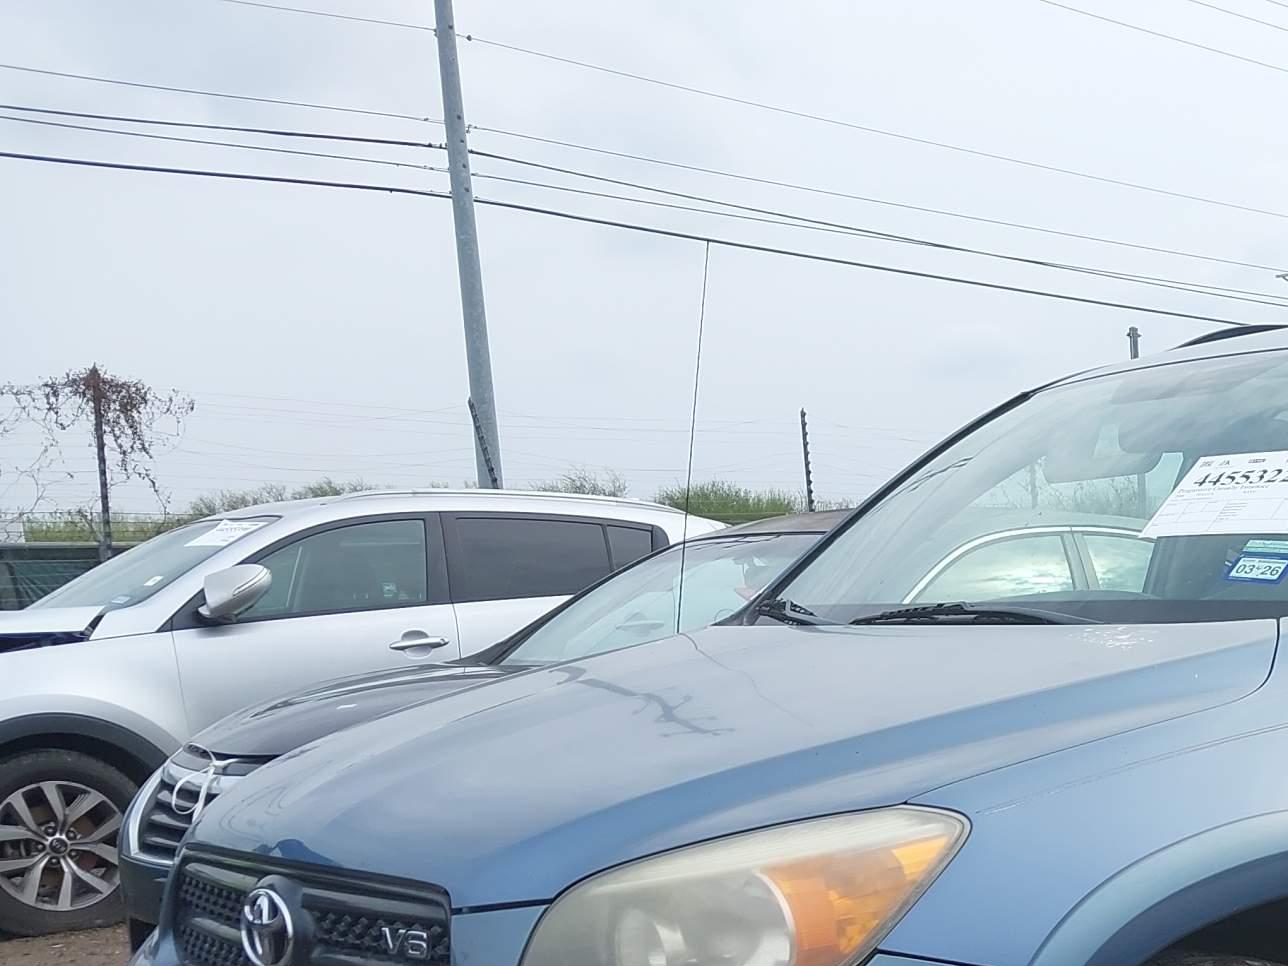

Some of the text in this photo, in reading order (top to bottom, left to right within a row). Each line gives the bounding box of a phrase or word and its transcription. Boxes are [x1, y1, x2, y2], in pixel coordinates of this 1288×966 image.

[1235, 563, 1282, 577] 03 26
[381, 926, 429, 958] V6
